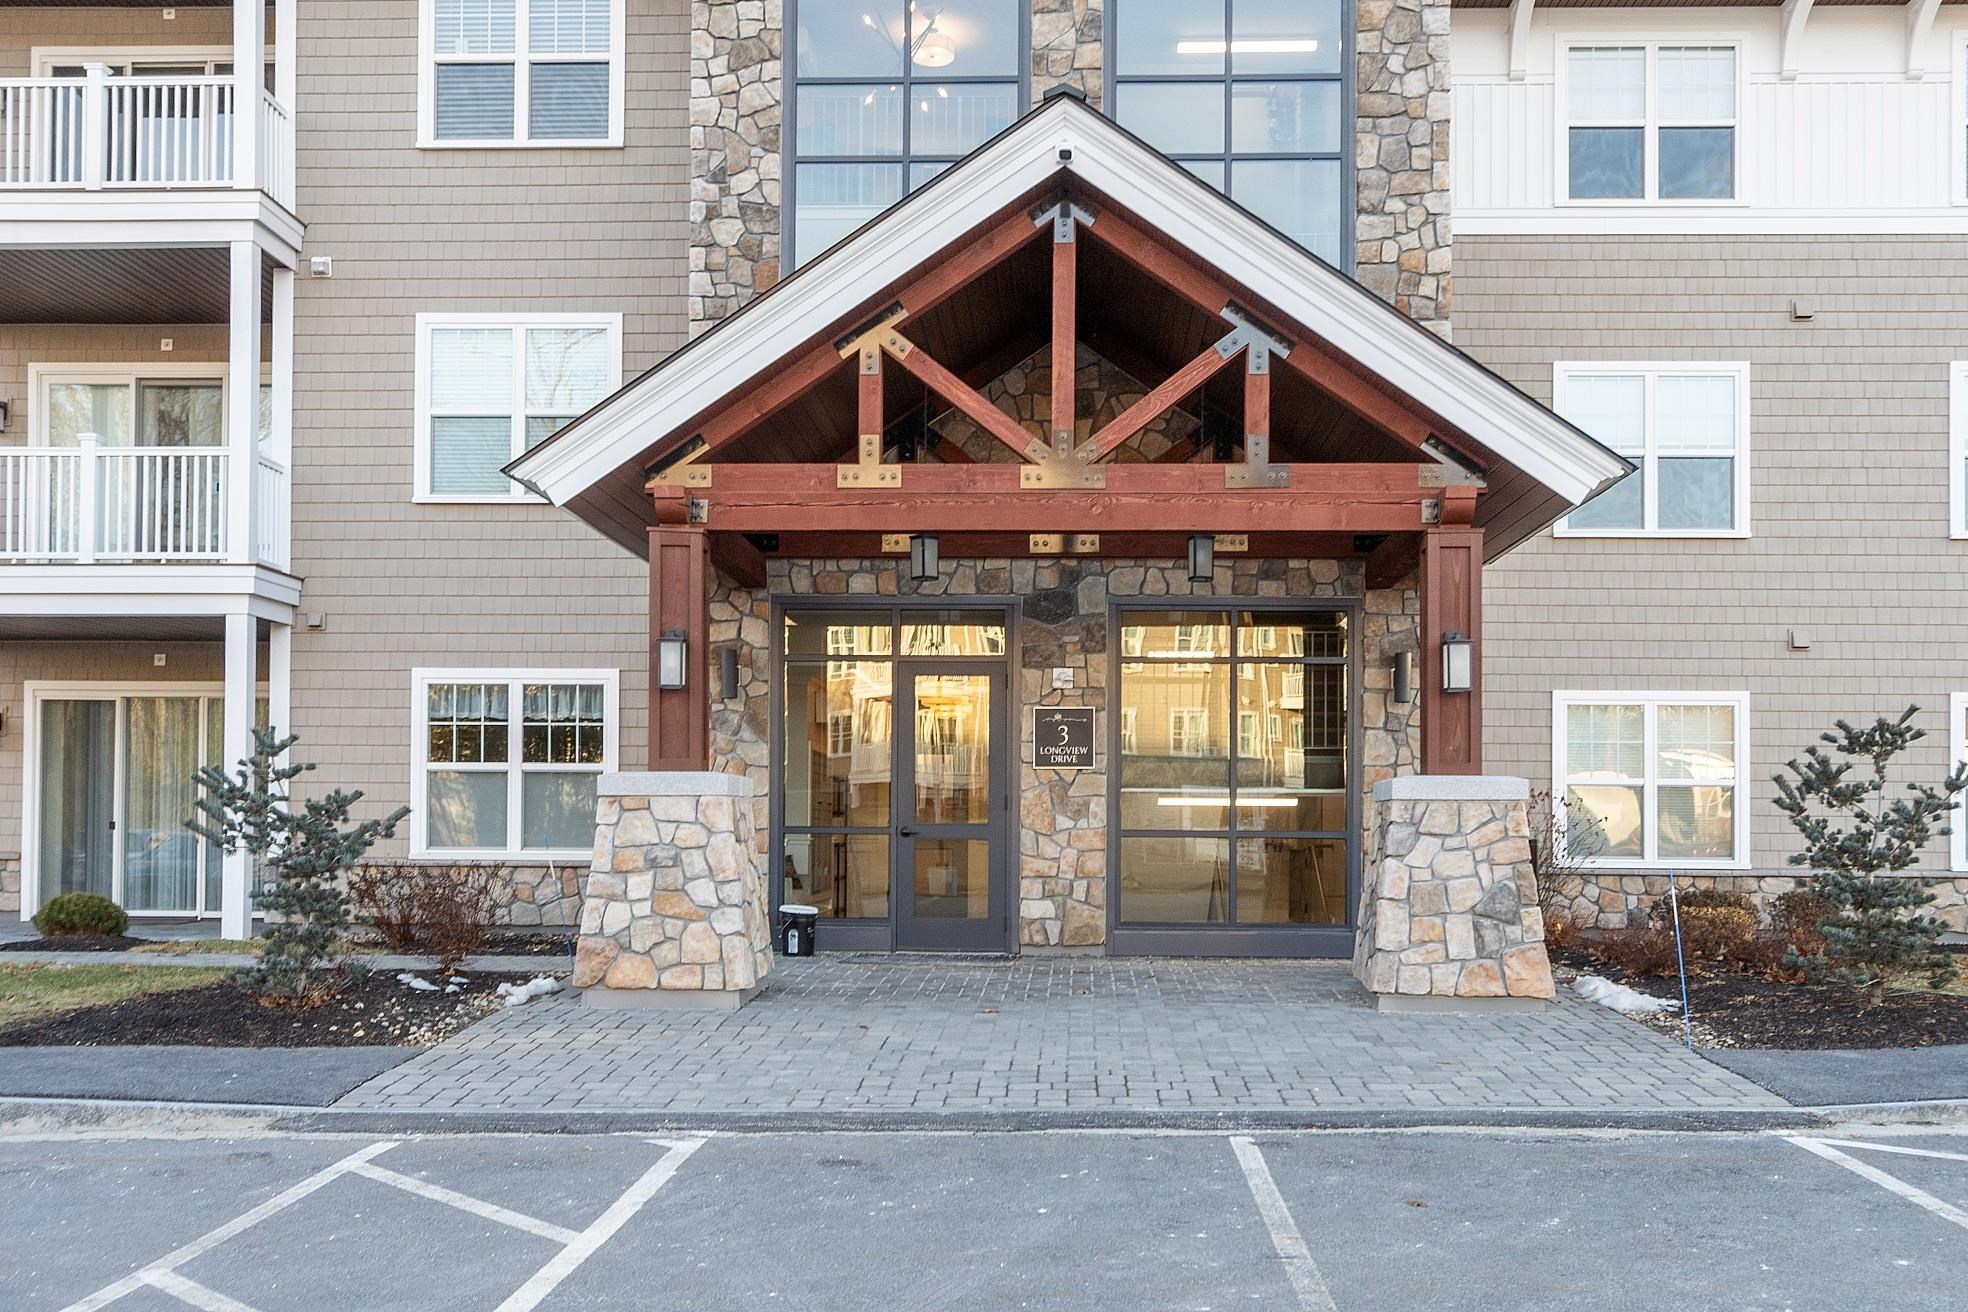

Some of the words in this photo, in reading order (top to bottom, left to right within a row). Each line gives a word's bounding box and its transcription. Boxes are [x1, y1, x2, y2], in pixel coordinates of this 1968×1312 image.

[1058, 725, 1069, 746] 3
[1040, 746, 1088, 755] LONGVIEW
[1050, 755, 1078, 763] DRIVE
